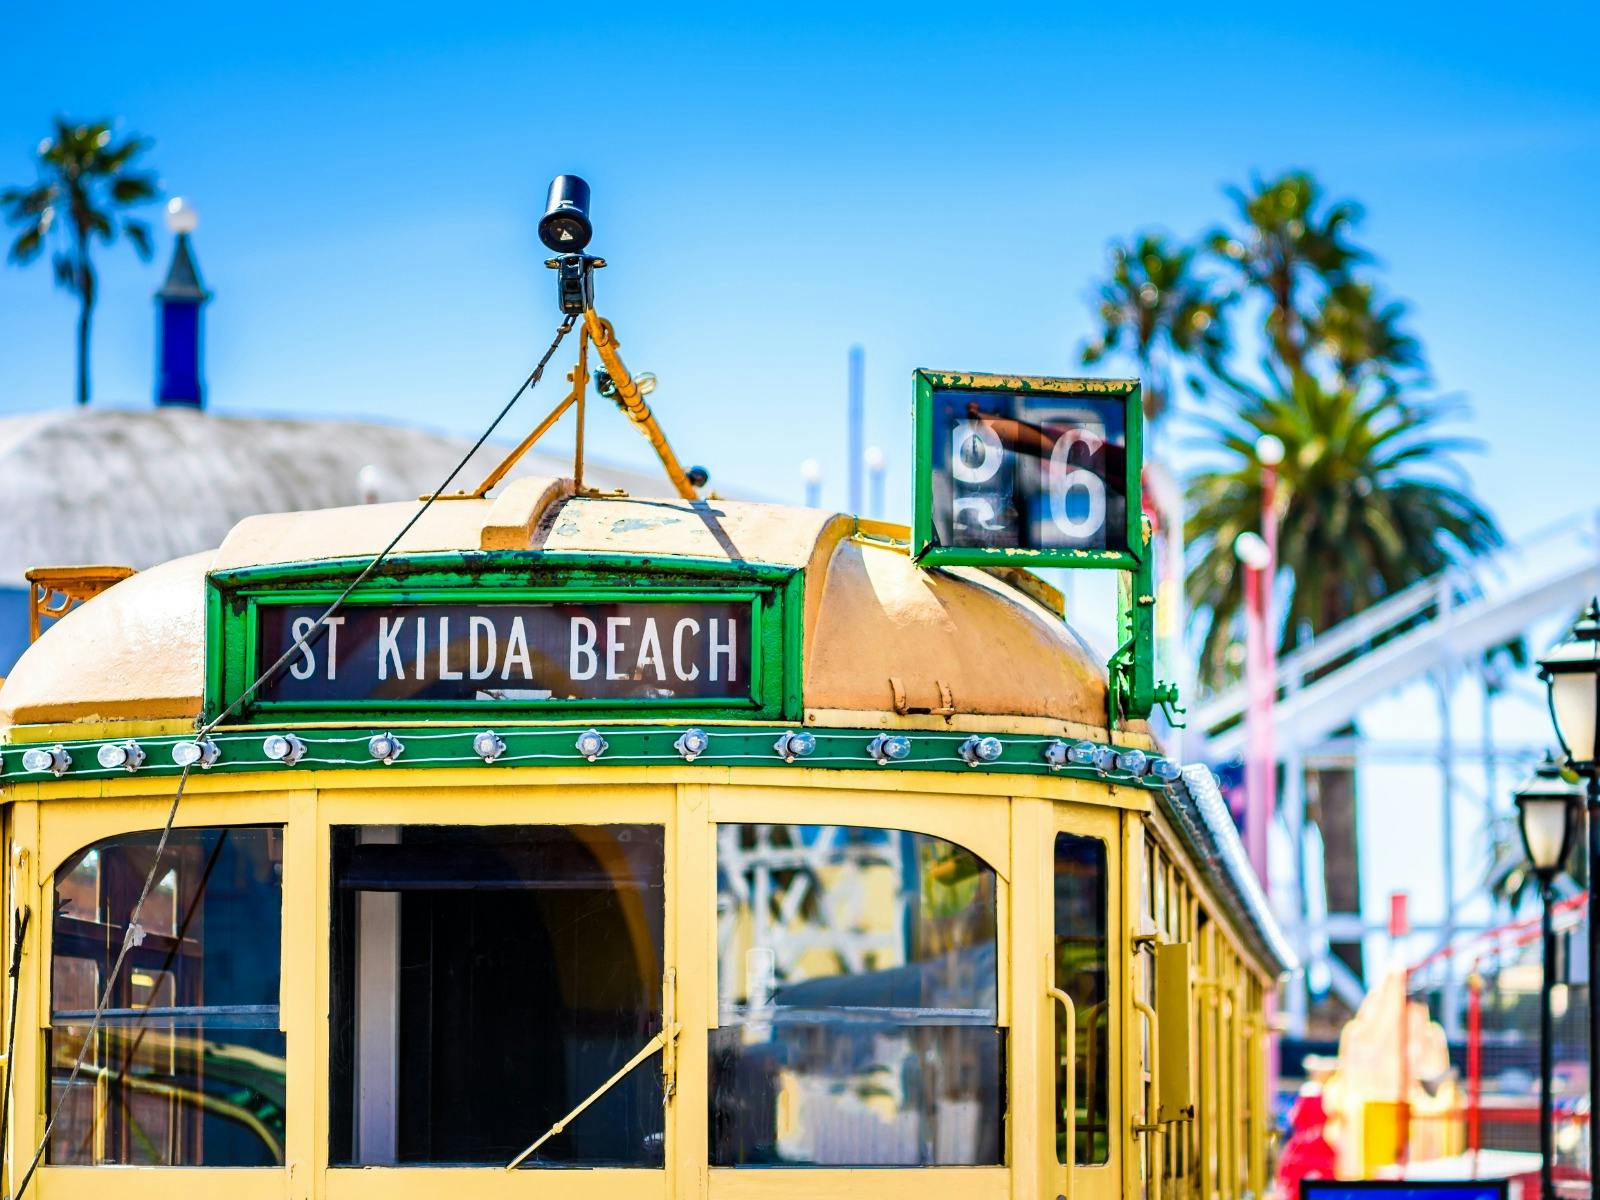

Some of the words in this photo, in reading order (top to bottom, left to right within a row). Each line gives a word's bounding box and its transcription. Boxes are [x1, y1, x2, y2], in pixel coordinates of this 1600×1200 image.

[290, 616, 345, 681] ST
[378, 616, 534, 681] KILDA
[569, 616, 738, 682] BEACH
